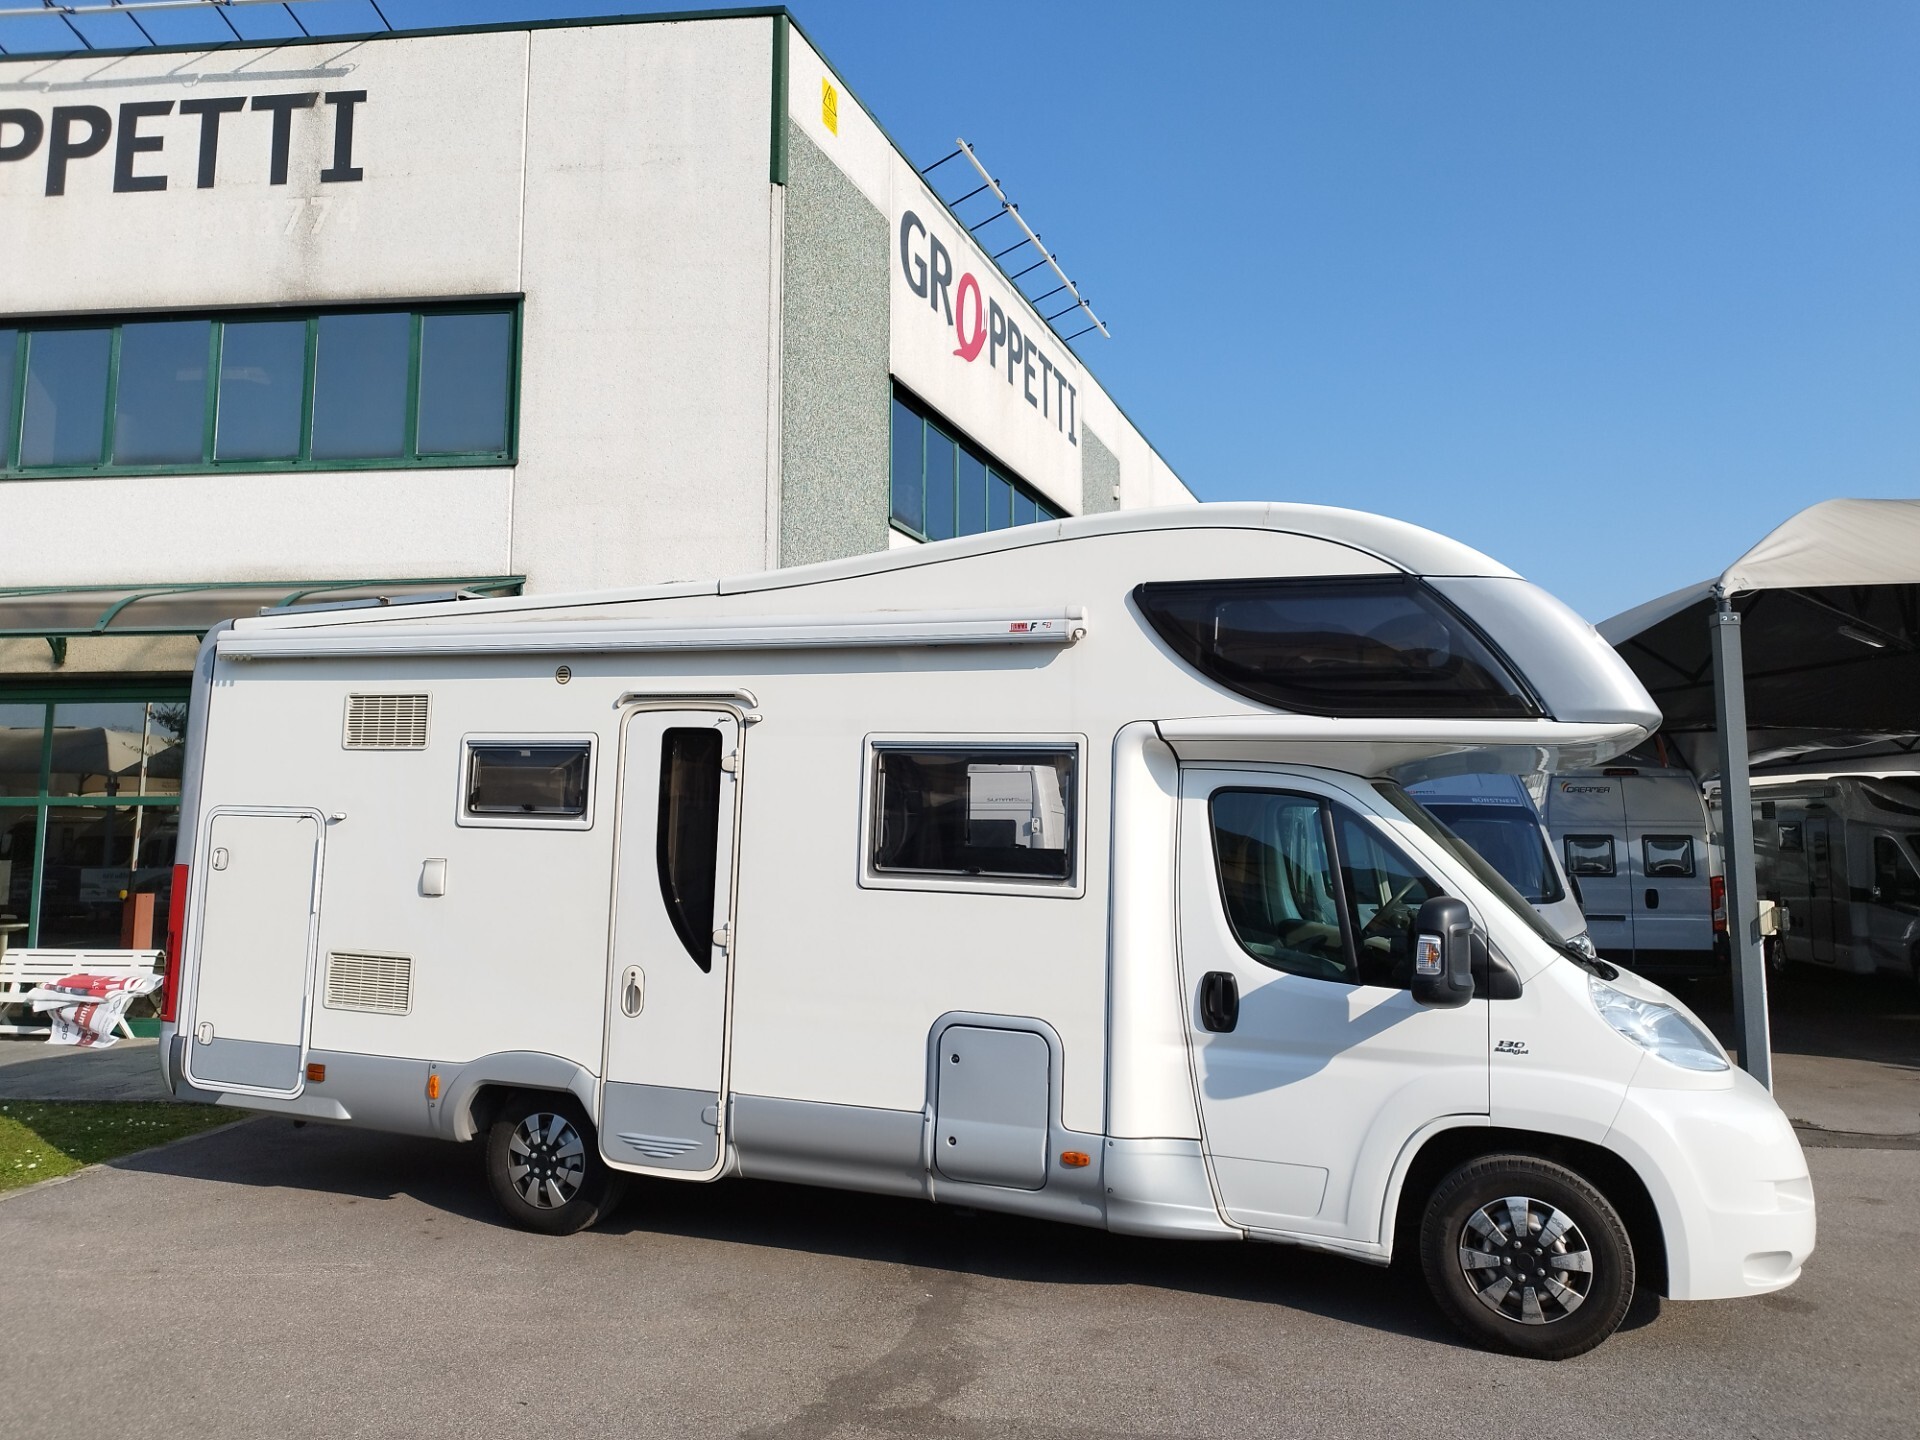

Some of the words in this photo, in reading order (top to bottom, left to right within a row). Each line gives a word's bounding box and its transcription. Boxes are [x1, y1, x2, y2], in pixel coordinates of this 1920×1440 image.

[900, 209, 1077, 446] GROPPETTI
[1471, 796, 1516, 804] BÜRSTNER
[1498, 1040, 1526, 1048] 130
